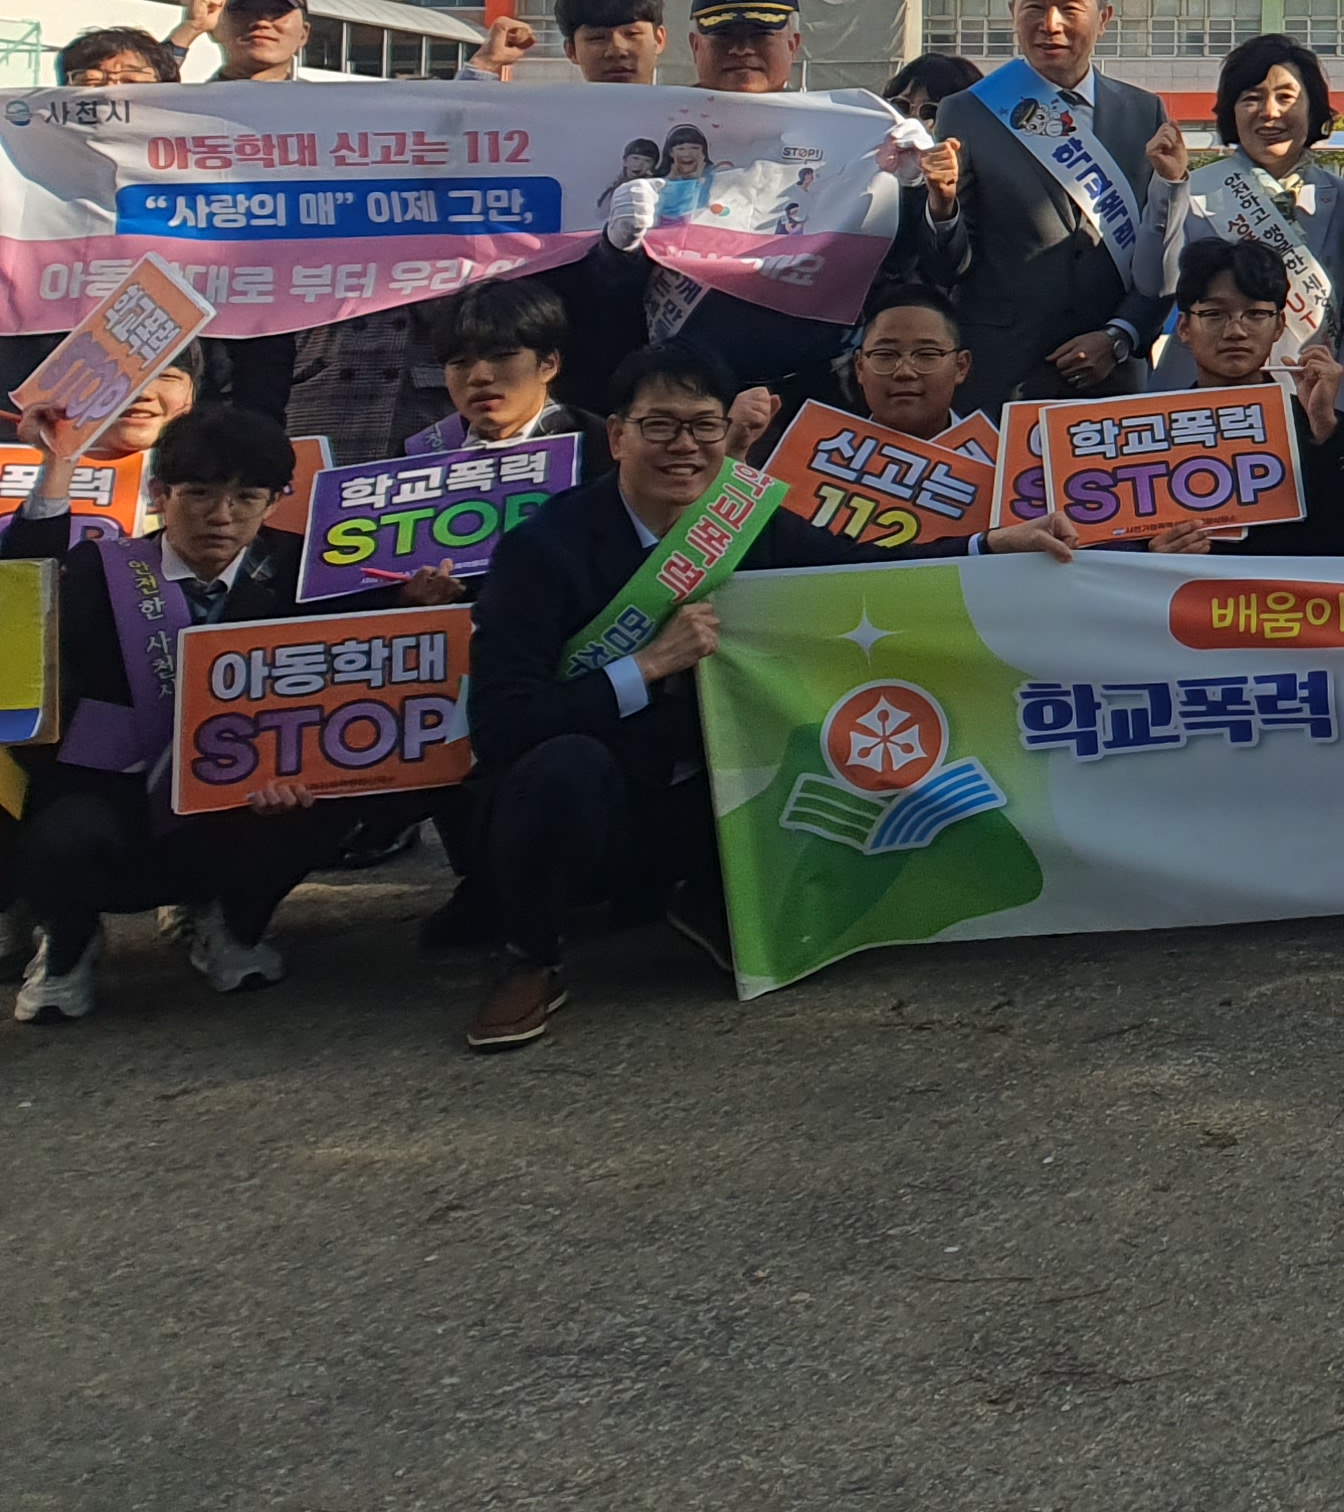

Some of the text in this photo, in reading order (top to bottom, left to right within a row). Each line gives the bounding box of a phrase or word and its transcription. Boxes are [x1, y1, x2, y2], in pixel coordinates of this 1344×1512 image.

[44, 100, 131, 125] 사천시
[147, 129, 533, 171] 아동학대 신고는 112
[366, 189, 439, 224] 이제
[447, 188, 534, 225] 그만,
[1224, 171, 1272, 227] 안전하고
[39, 258, 275, 305] 아동대로
[290, 261, 377, 304] 부터
[102, 281, 182, 372] 학교폭력
[1068, 403, 1267, 459] 학교폭력
[340, 449, 549, 510] 학교폭력
[808, 428, 978, 520] 신고는
[1063, 451, 1287, 525] STOP
[809, 482, 922, 549] 112
[127, 559, 167, 621] 안전한
[210, 631, 448, 701] 아동학대
[191, 694, 459, 786] STOP
[1019, 668, 1339, 761] 학교폭력
